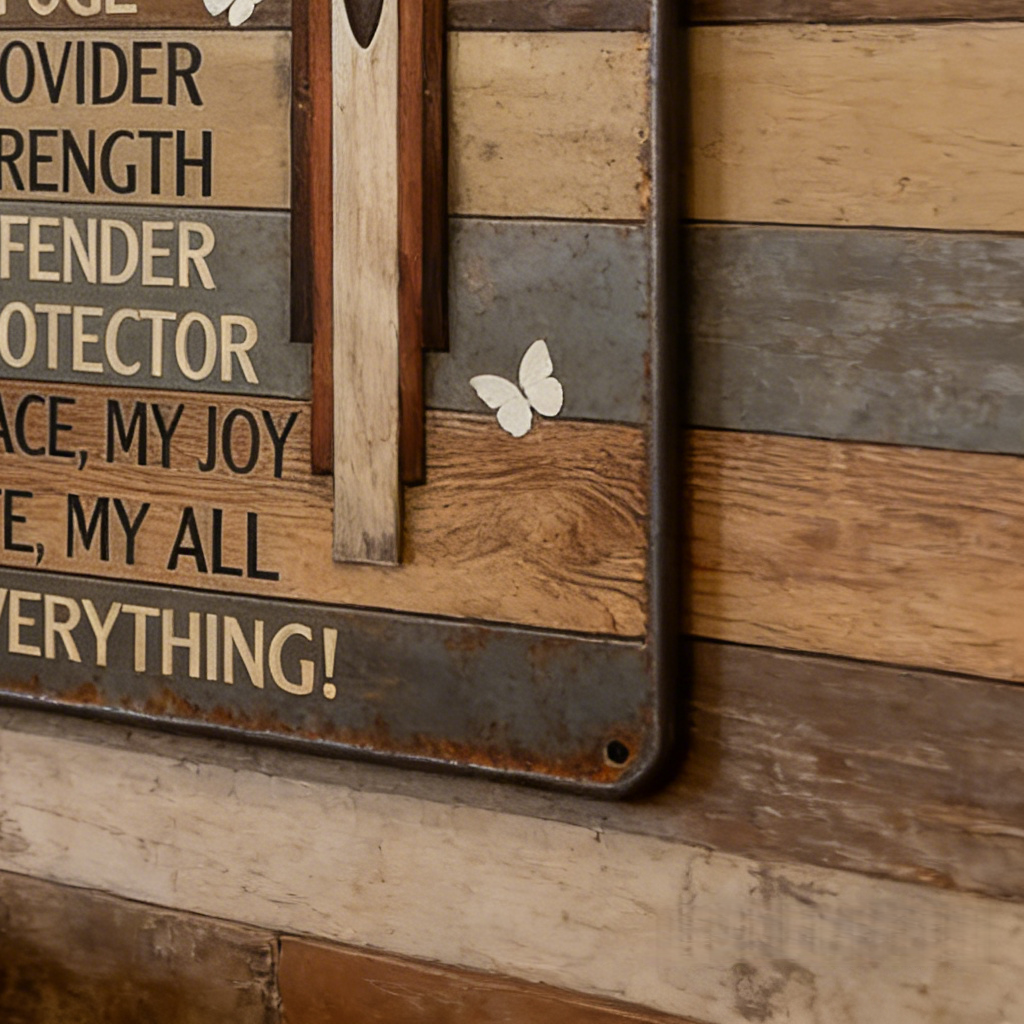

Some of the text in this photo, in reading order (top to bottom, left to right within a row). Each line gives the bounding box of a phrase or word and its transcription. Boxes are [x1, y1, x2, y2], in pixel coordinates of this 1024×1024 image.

[106, 399, 185, 469] MY
[198, 405, 298, 477] JOY
[66, 492, 151, 565] MY
[167, 506, 280, 581] ALL
